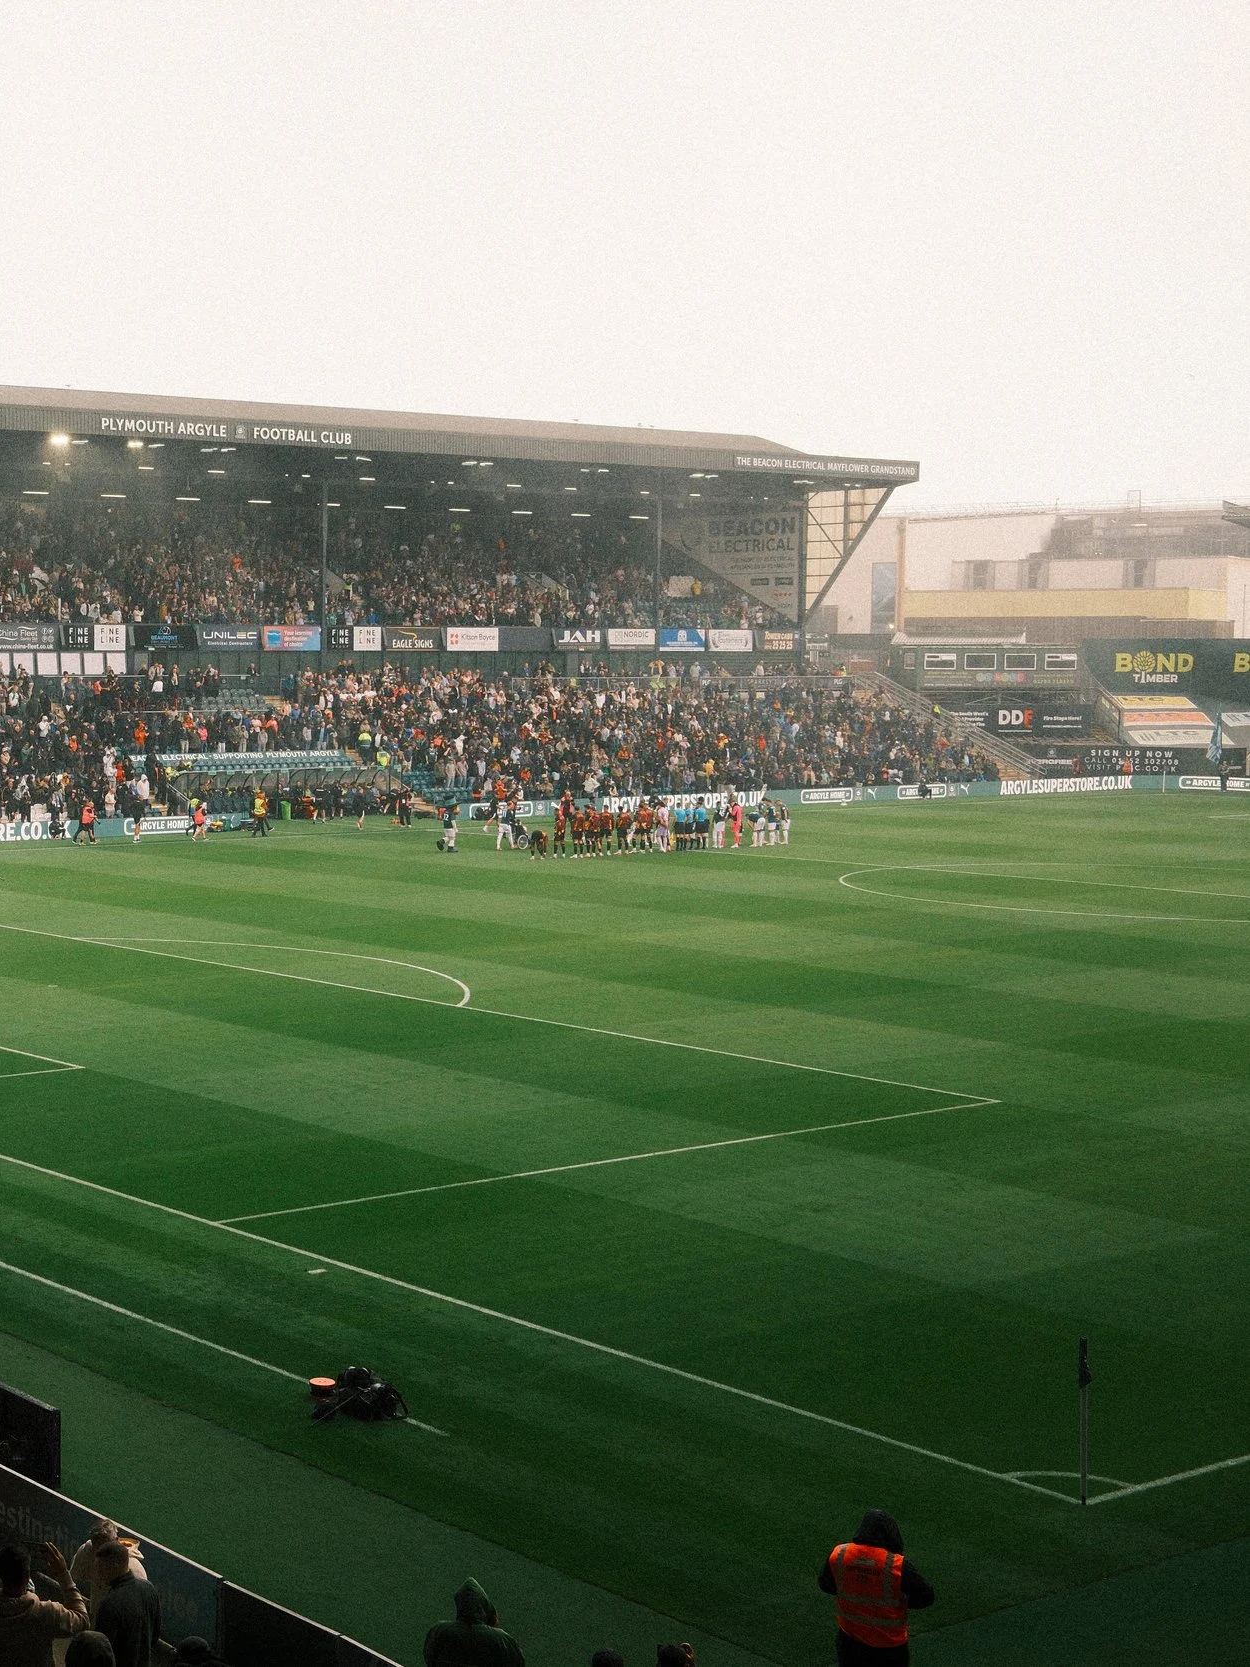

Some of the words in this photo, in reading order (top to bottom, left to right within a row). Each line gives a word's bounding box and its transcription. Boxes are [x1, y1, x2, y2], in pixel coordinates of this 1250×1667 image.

[101, 417, 174, 434] PLYMOUTH
[177, 422, 227, 438] ARGYLE
[253, 427, 318, 443] FOOTBALL
[320, 431, 353, 445] CLUB
[736, 456, 752, 466] THE
[753, 457, 783, 468] BEACON
[784, 459, 826, 471] ELECTRICAL
[827, 462, 869, 474] MAYFLOWER
[870, 464, 916, 477] GRANDSTAND
[708, 517, 796, 537] BEACON
[708, 538, 795, 554] ELECTRICAL
[20, 628, 39, 637] Fleet
[203, 631, 258, 640] UNILEC
[461, 633, 478, 641] Kitson
[479, 633, 496, 641] Boyce
[558, 630, 601, 643] JAH
[623, 630, 650, 638] NORDIC
[392, 639, 413, 649] EAGLE
[414, 639, 434, 649] SIGNS
[1114, 650, 1194, 673] BOND
[1133, 671, 1179, 684] TIMBER
[162, 752, 208, 762] ELECTRICAL
[213, 751, 264, 761] SUPPORTING
[266, 750, 307, 759] PLYMOUTH
[309, 749, 340, 758] ARGYLE
[1090, 749, 1120, 757] SIGN
[1125, 749, 1142, 757] UP
[1146, 750, 1174, 758] NOW
[1000, 775, 1133, 796] ARGYLESUPERSTORE.CO.UK
[1192, 779, 1222, 787] ARGYLE
[809, 791, 829, 800] ARGYLE
[830, 791, 846, 800] HOME
[167, 820, 189, 829] HOME
